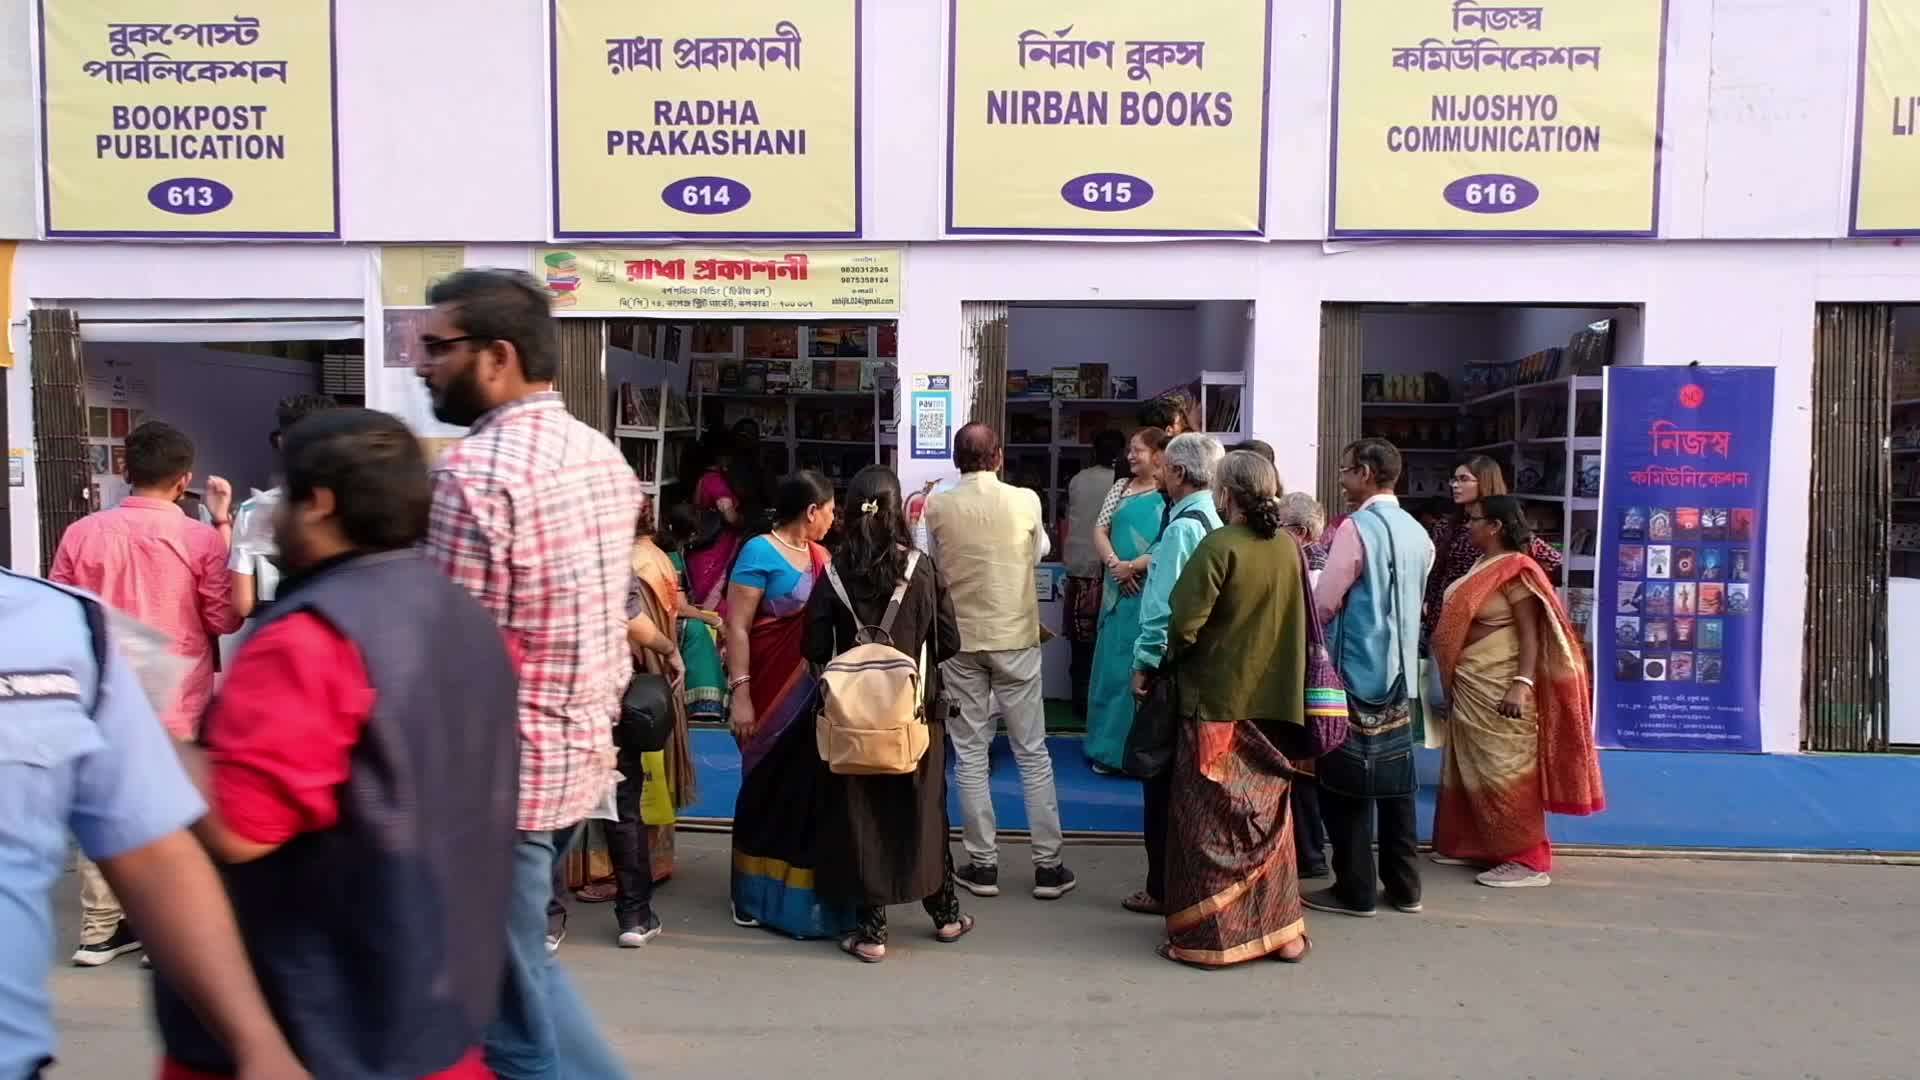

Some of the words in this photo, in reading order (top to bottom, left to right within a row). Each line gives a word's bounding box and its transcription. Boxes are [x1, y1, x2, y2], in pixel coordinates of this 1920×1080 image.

[1452, 1, 1543, 34] নিজস্ব
[108, 15, 261, 56] বুকপোস্ট
[606, 36, 662, 75] রাধা
[673, 20, 803, 73] প্রকাশনী
[1018, 24, 1115, 70] নির্বাণ
[1125, 40, 1205, 83] বুকস
[1391, 38, 1601, 73] কমিউনিকেশন
[82, 52, 288, 85] পাবলিকেশন
[112, 105, 267, 131] BOOKPOST
[653, 99, 760, 126] RADHA
[986, 90, 1108, 125] NIRBAN
[1120, 91, 1233, 127] BOOKS
[1431, 94, 1558, 121] NIJOSHYO
[1893, 96, 1920, 136] LI
[95, 134, 285, 161] PUBLICATION
[607, 130, 806, 156] PRAKASHANI
[1387, 125, 1601, 153] COMMUNICATION
[167, 186, 214, 207] 613
[682, 185, 730, 206] 614
[1083, 182, 1132, 203] 615
[1465, 182, 1517, 206] 616
[624, 258, 686, 281] রাধা
[693, 253, 810, 281] প্রকাশনী
